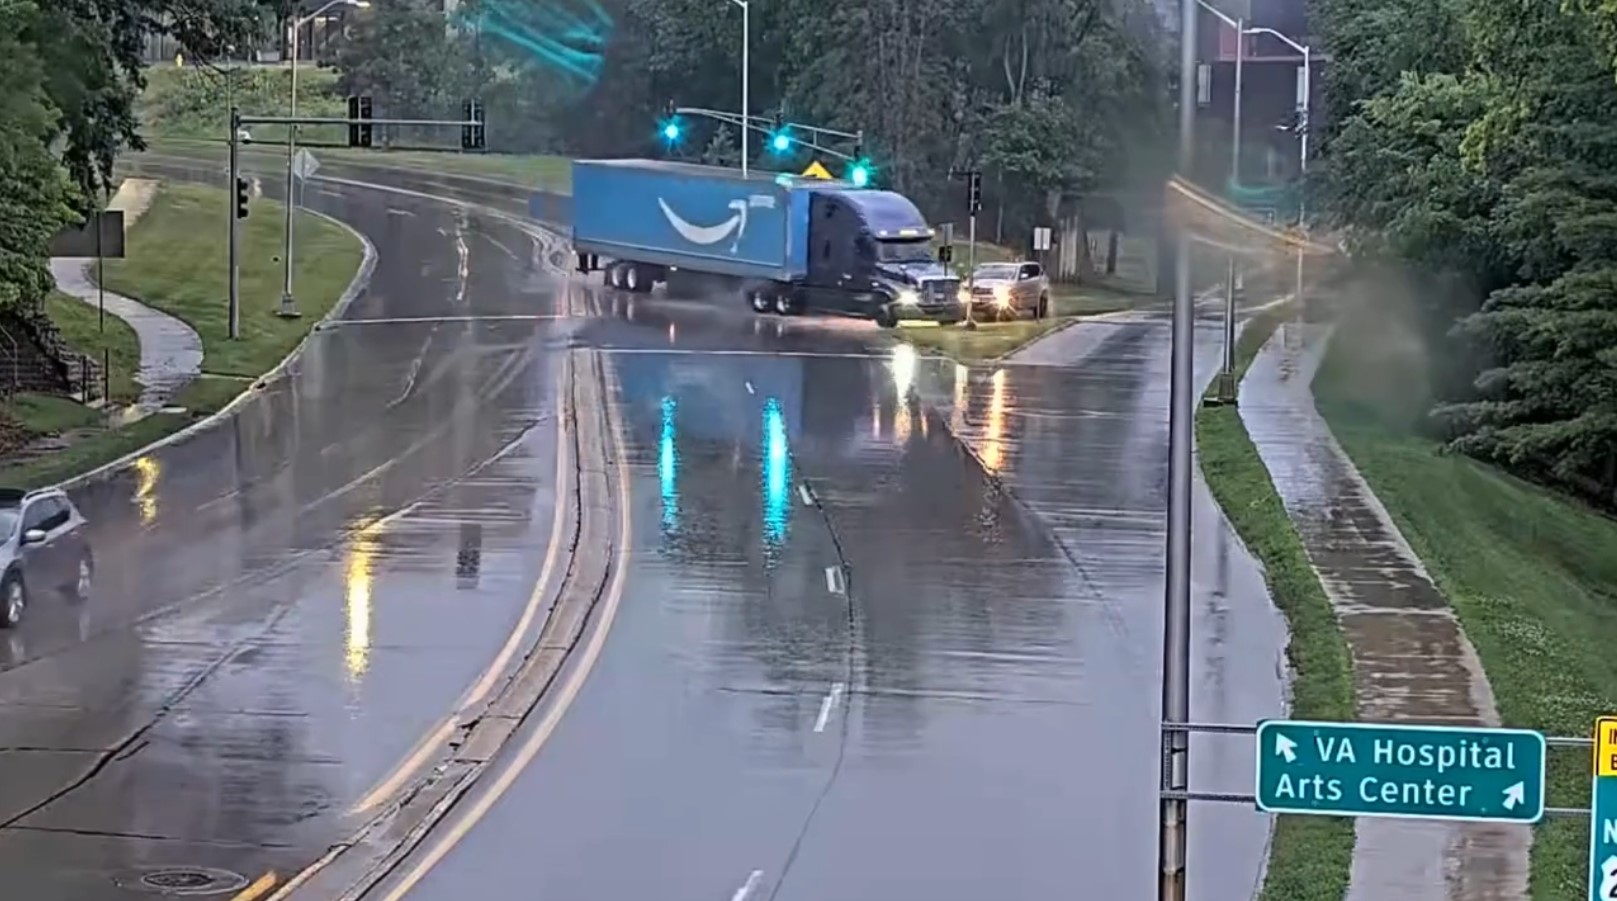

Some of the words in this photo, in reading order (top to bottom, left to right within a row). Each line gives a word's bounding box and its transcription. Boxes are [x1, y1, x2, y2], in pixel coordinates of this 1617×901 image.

[1316, 737, 1356, 763] VA
[1374, 739, 1515, 773] Hospital
[1275, 773, 1342, 801] Arts
[1359, 776, 1472, 806] Center
